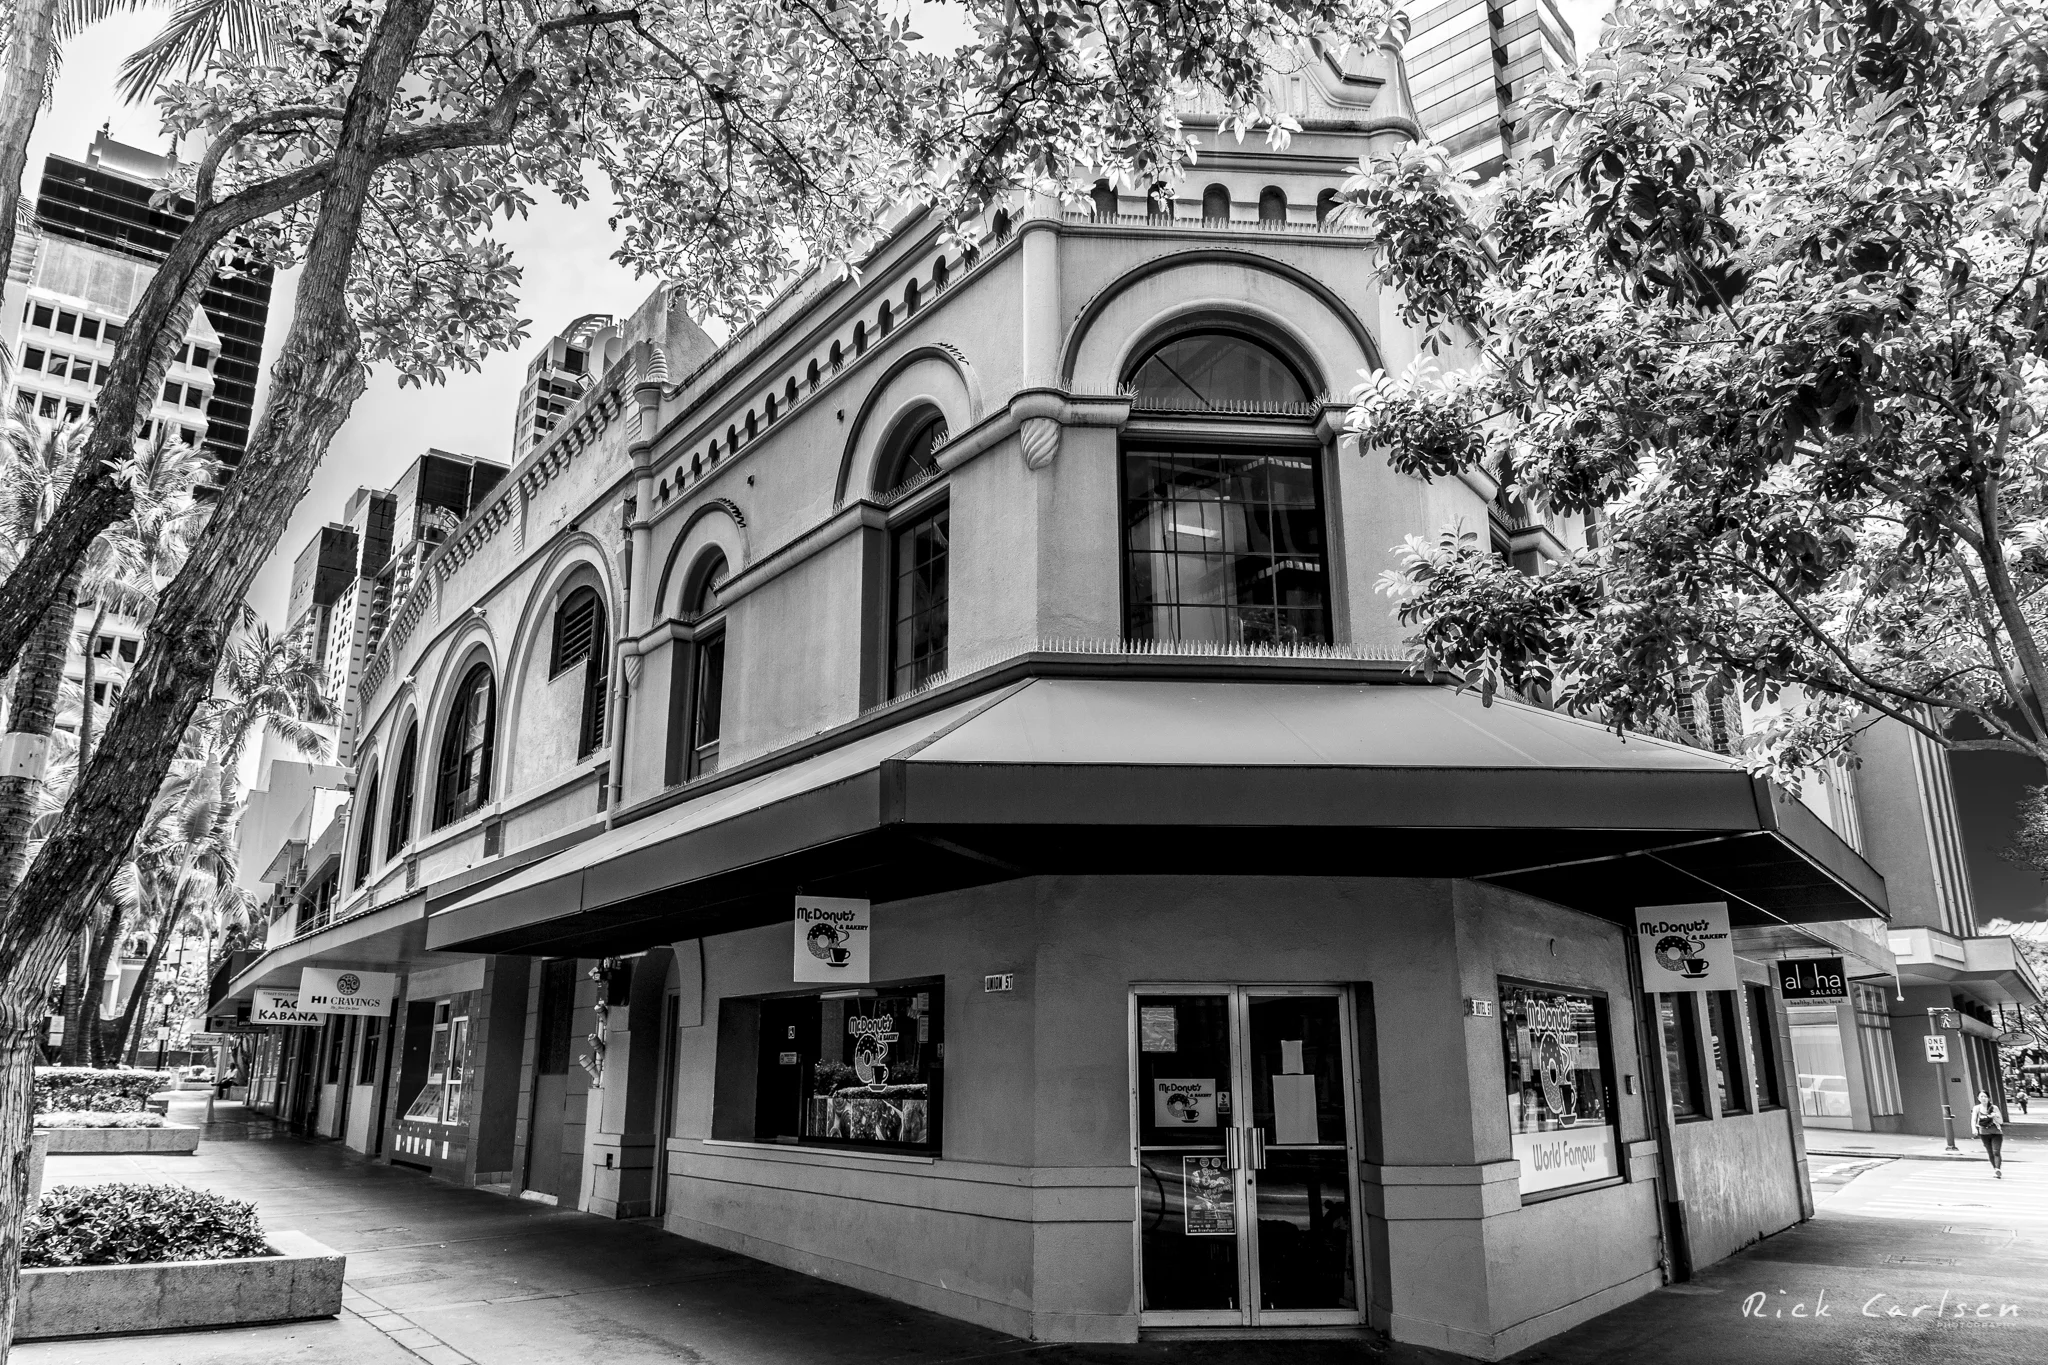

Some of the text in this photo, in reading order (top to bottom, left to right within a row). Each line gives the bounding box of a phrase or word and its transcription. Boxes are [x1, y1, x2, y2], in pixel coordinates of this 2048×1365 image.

[986, 975, 1013, 990] UNION ST
[273, 998, 299, 1009] TAC
[310, 996, 327, 1004] HI
[330, 996, 380, 1008] CRAVINGS
[258, 1009, 318, 1021] KABANA
[1532, 1140, 1596, 1172] World Famous
